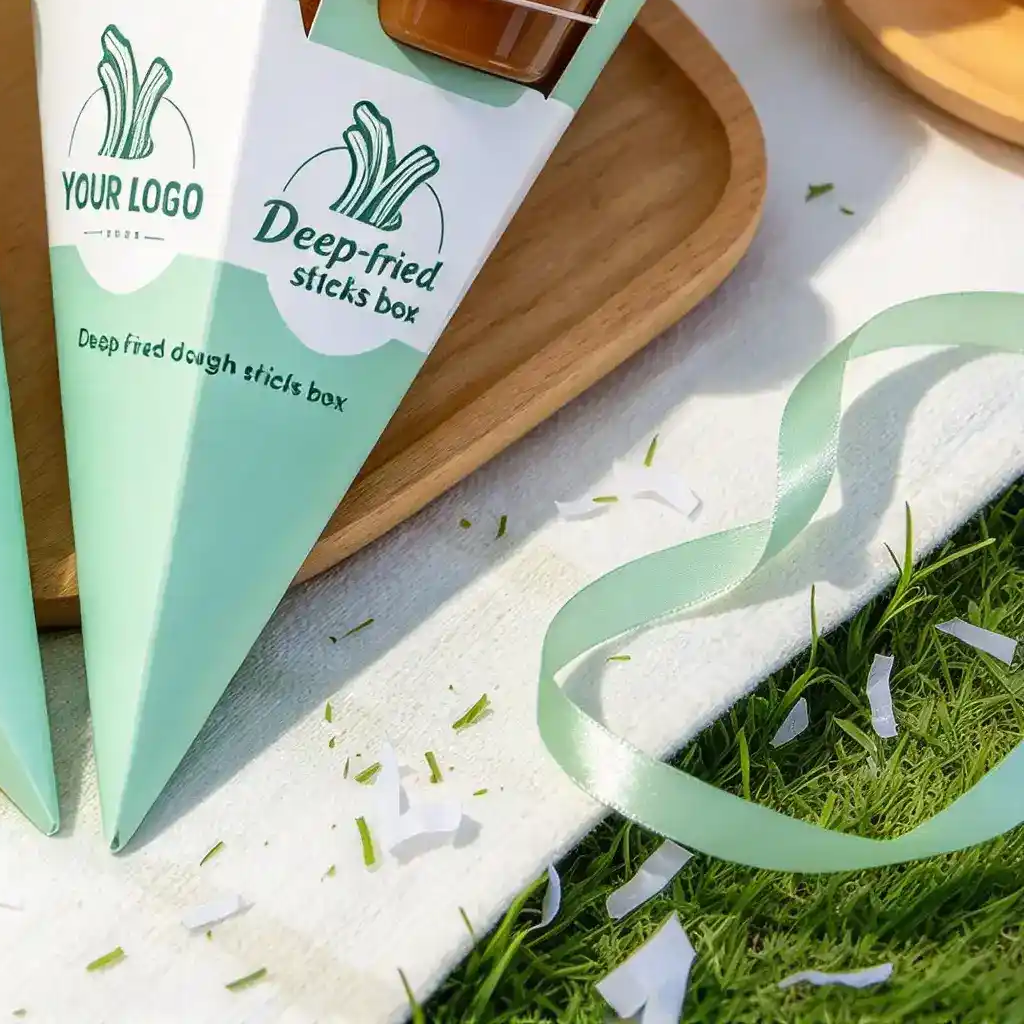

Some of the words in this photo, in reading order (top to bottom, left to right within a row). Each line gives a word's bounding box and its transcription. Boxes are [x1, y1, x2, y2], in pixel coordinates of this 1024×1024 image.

[62, 171, 122, 211] YOUR
[128, 177, 204, 220] LOGO
[253, 199, 443, 291] Deep-fried
[290, 265, 371, 307] sticks
[374, 286, 419, 323] box
[307, 381, 348, 412] box
